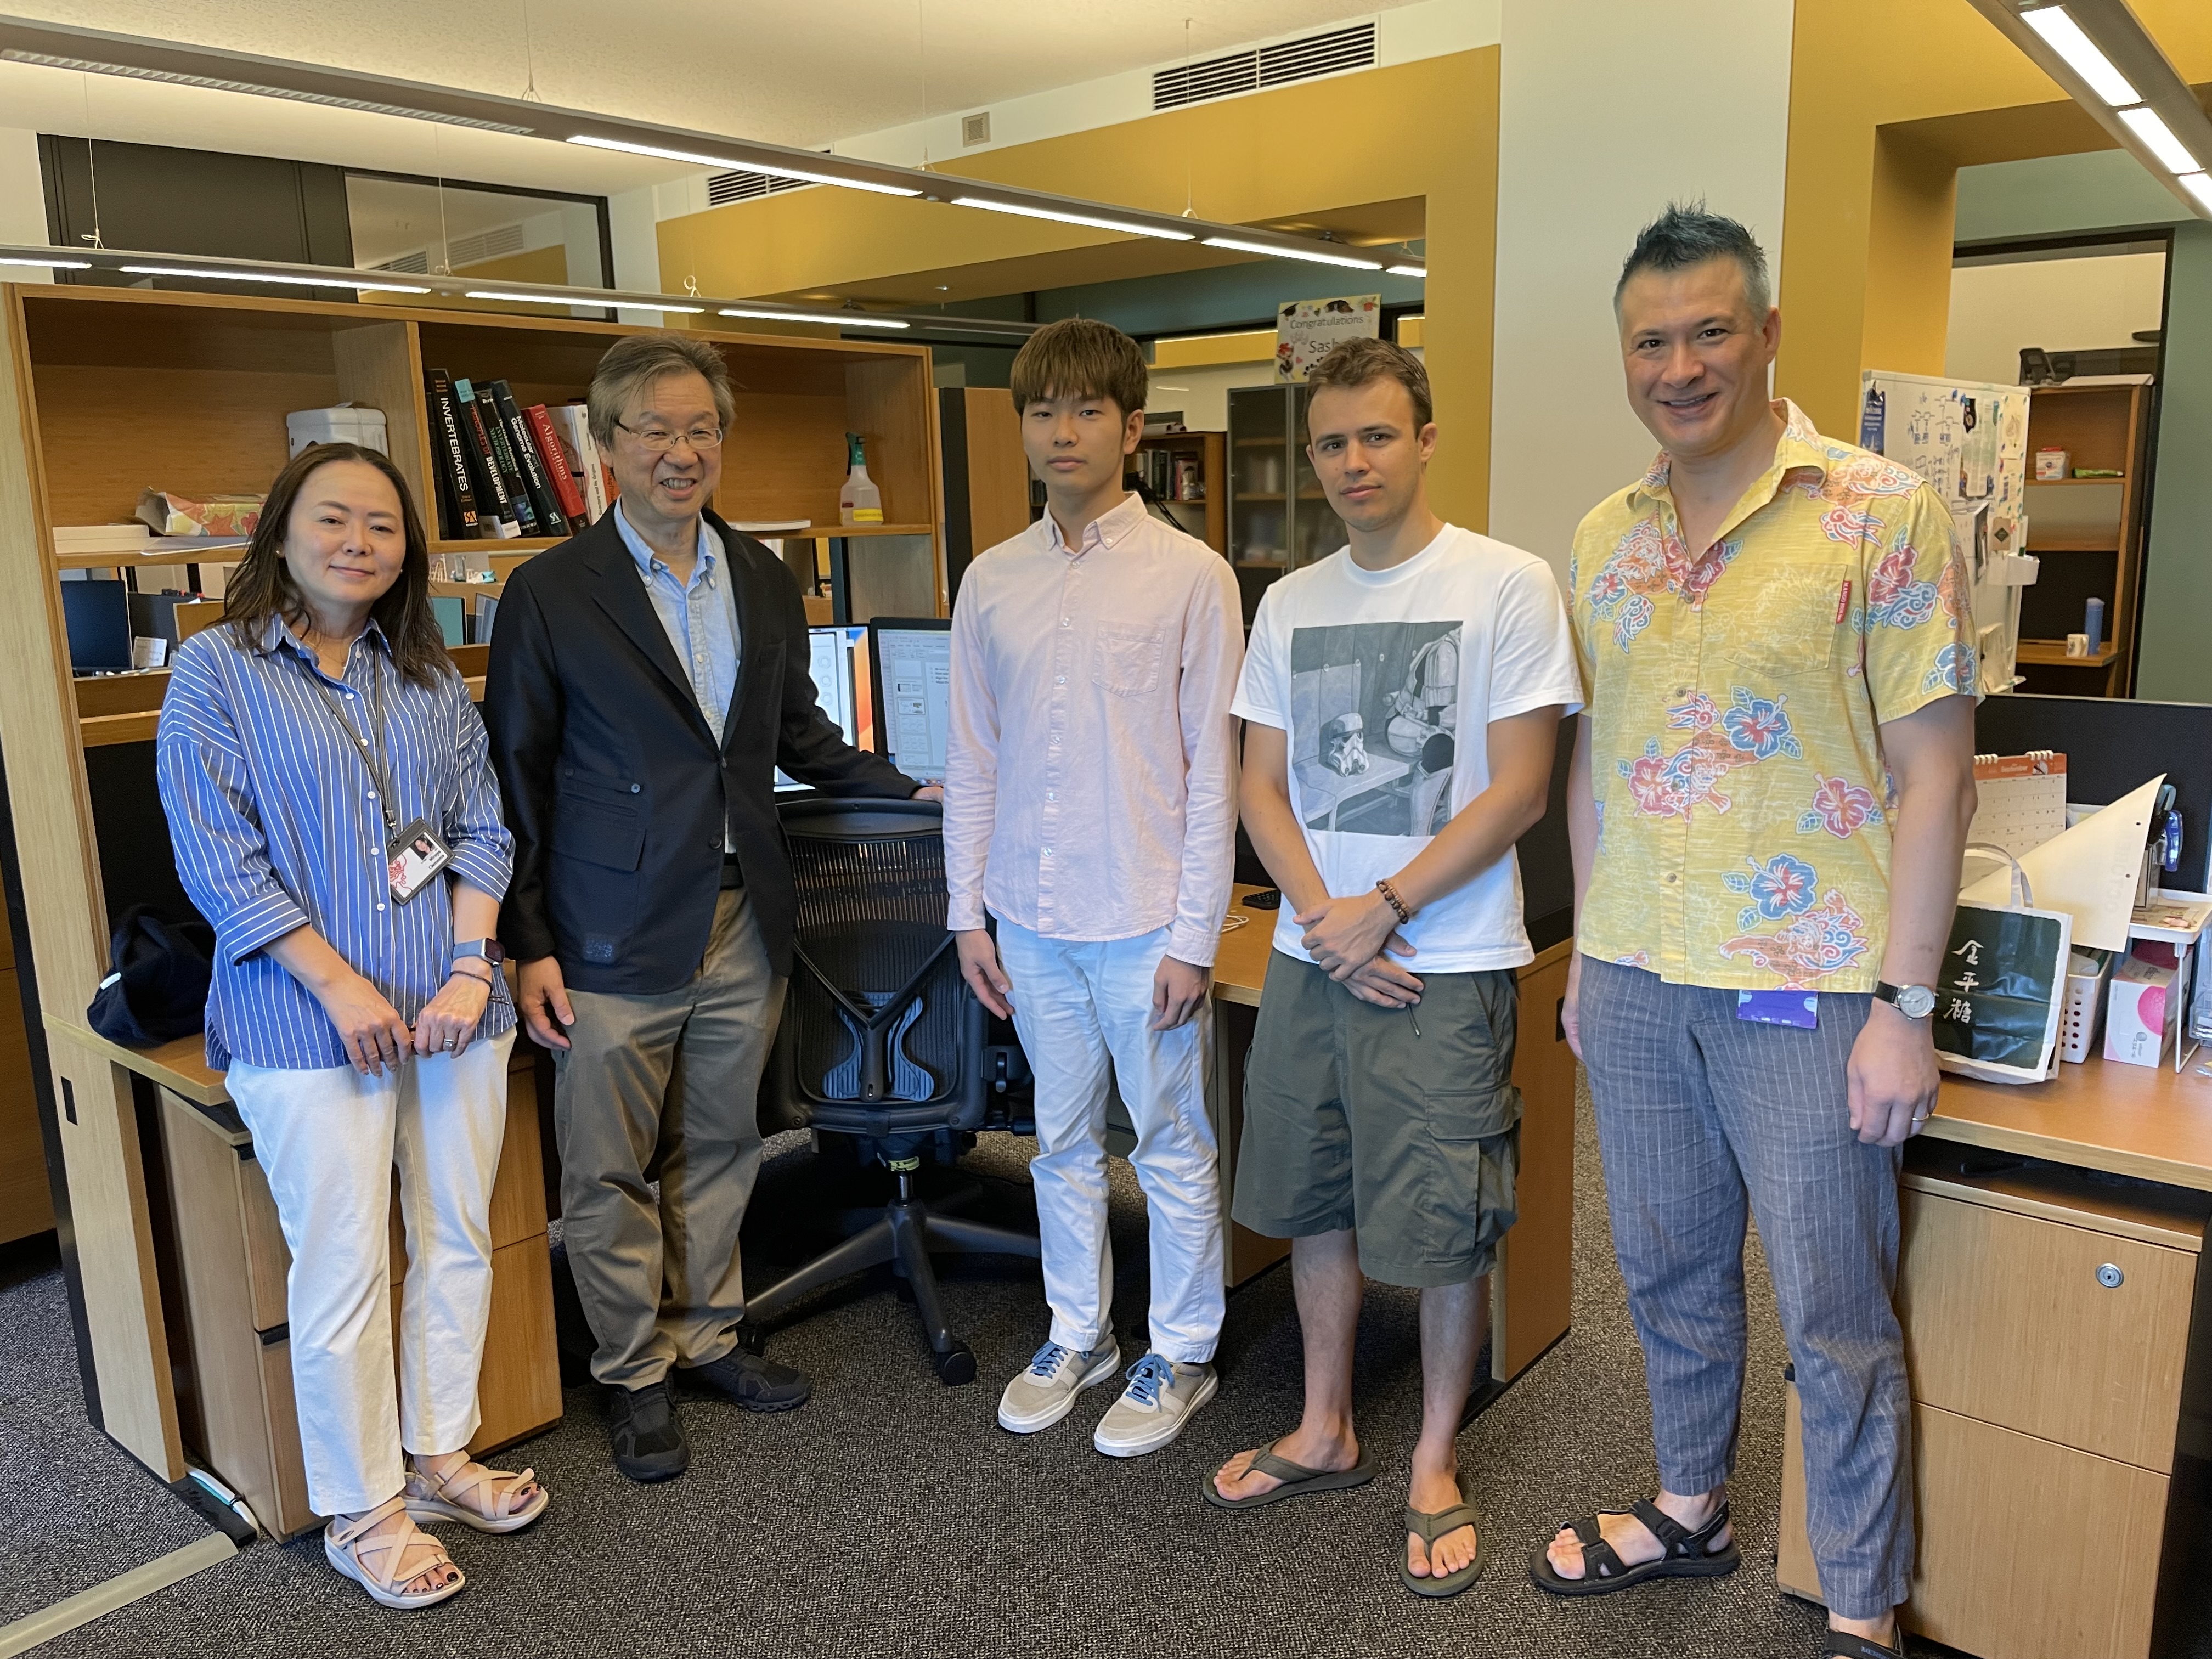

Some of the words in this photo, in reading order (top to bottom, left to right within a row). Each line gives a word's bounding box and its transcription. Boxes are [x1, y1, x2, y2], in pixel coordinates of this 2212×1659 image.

[1290, 317, 1364, 329] Congratulations
[440, 397, 469, 492] INVERTEBRATES
[483, 446, 492, 456] OF
[511, 417, 527, 452] Genome
[524, 453, 541, 489] Evolution
[516, 416, 534, 454] Molecular
[532, 455, 540, 467] and
[543, 424, 568, 480] Algorithms
[486, 456, 507, 504] DEVELOPMENT
[1943, 939, 1984, 1024] 金平糖
